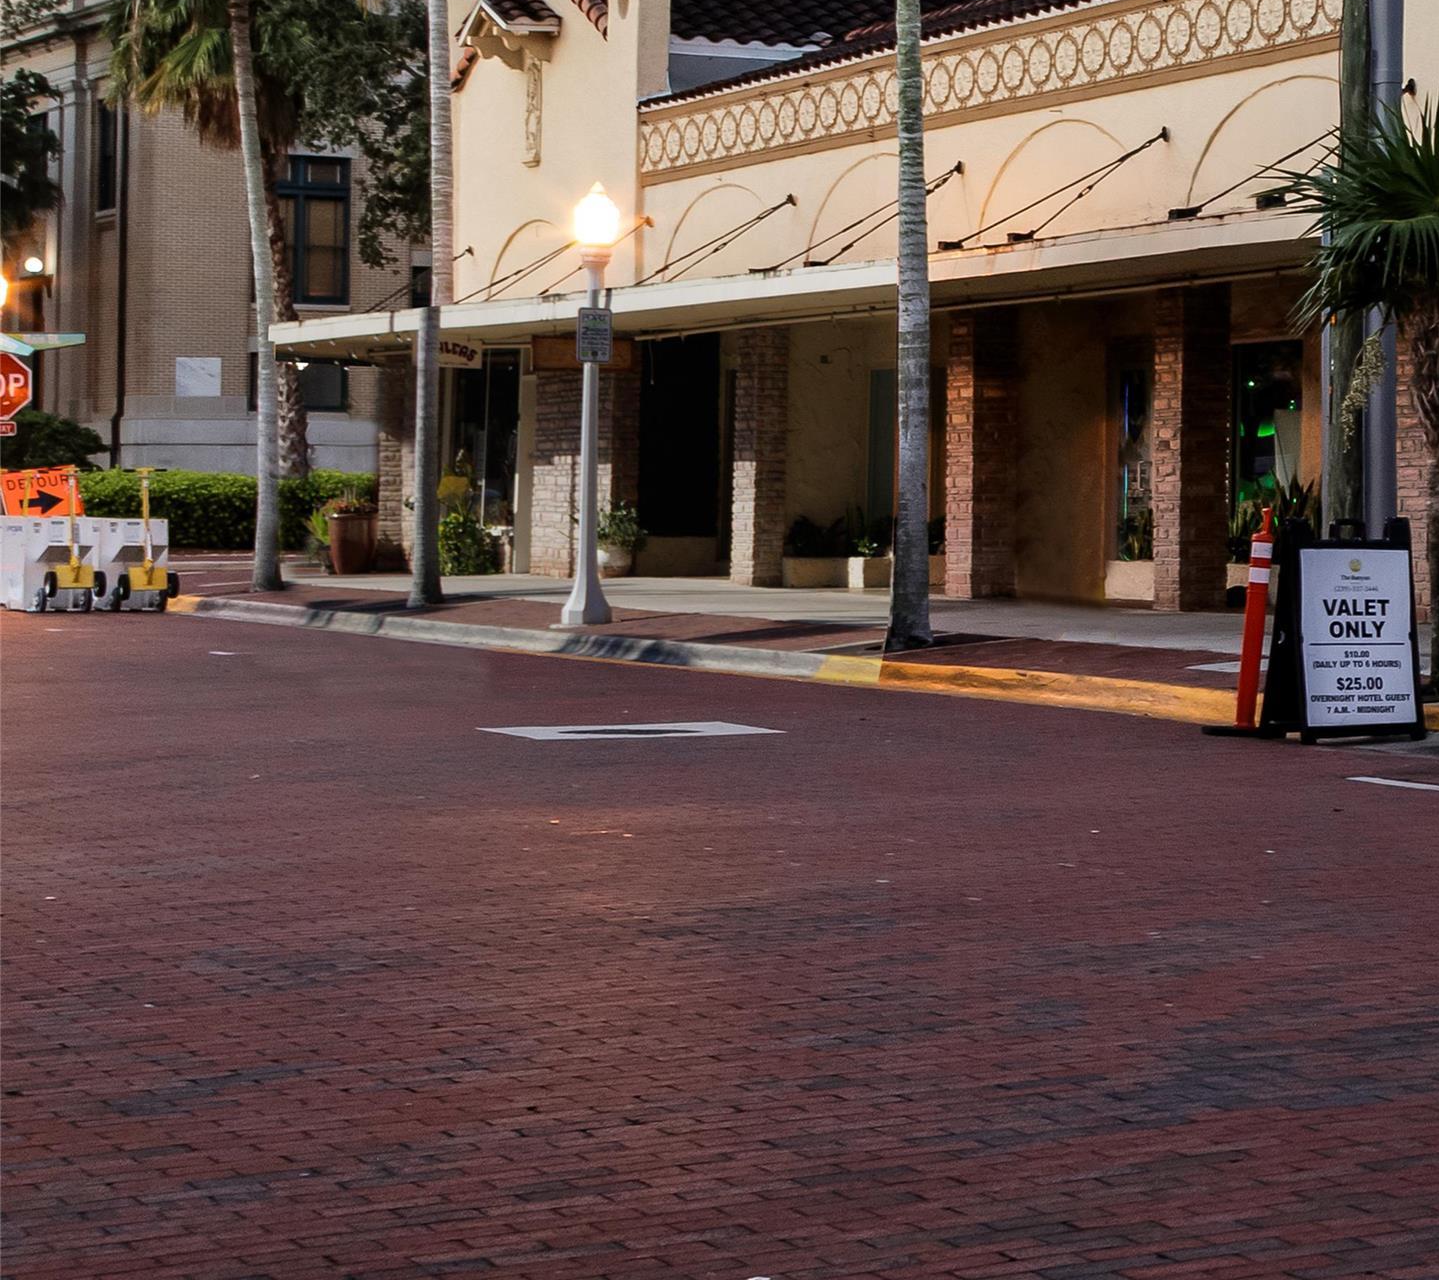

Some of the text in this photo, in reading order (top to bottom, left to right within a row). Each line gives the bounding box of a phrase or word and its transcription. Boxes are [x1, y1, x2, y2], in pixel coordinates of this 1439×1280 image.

[1322, 599, 1390, 616] VALET
[1329, 621, 1386, 638] ONLY
[1344, 650, 1370, 658] $10.00
[1312, 661, 1337, 670] (DAILY
[1365, 660, 1370, 668] 6
[1372, 660, 1402, 670] HOURS)
[1336, 677, 1384, 691] $25.00
[1310, 693, 1411, 703] OVERNIGHT HOTEL GUEST
[1327, 706, 1332, 714] 7
[1357, 705, 1396, 713] MIDNIGHT
